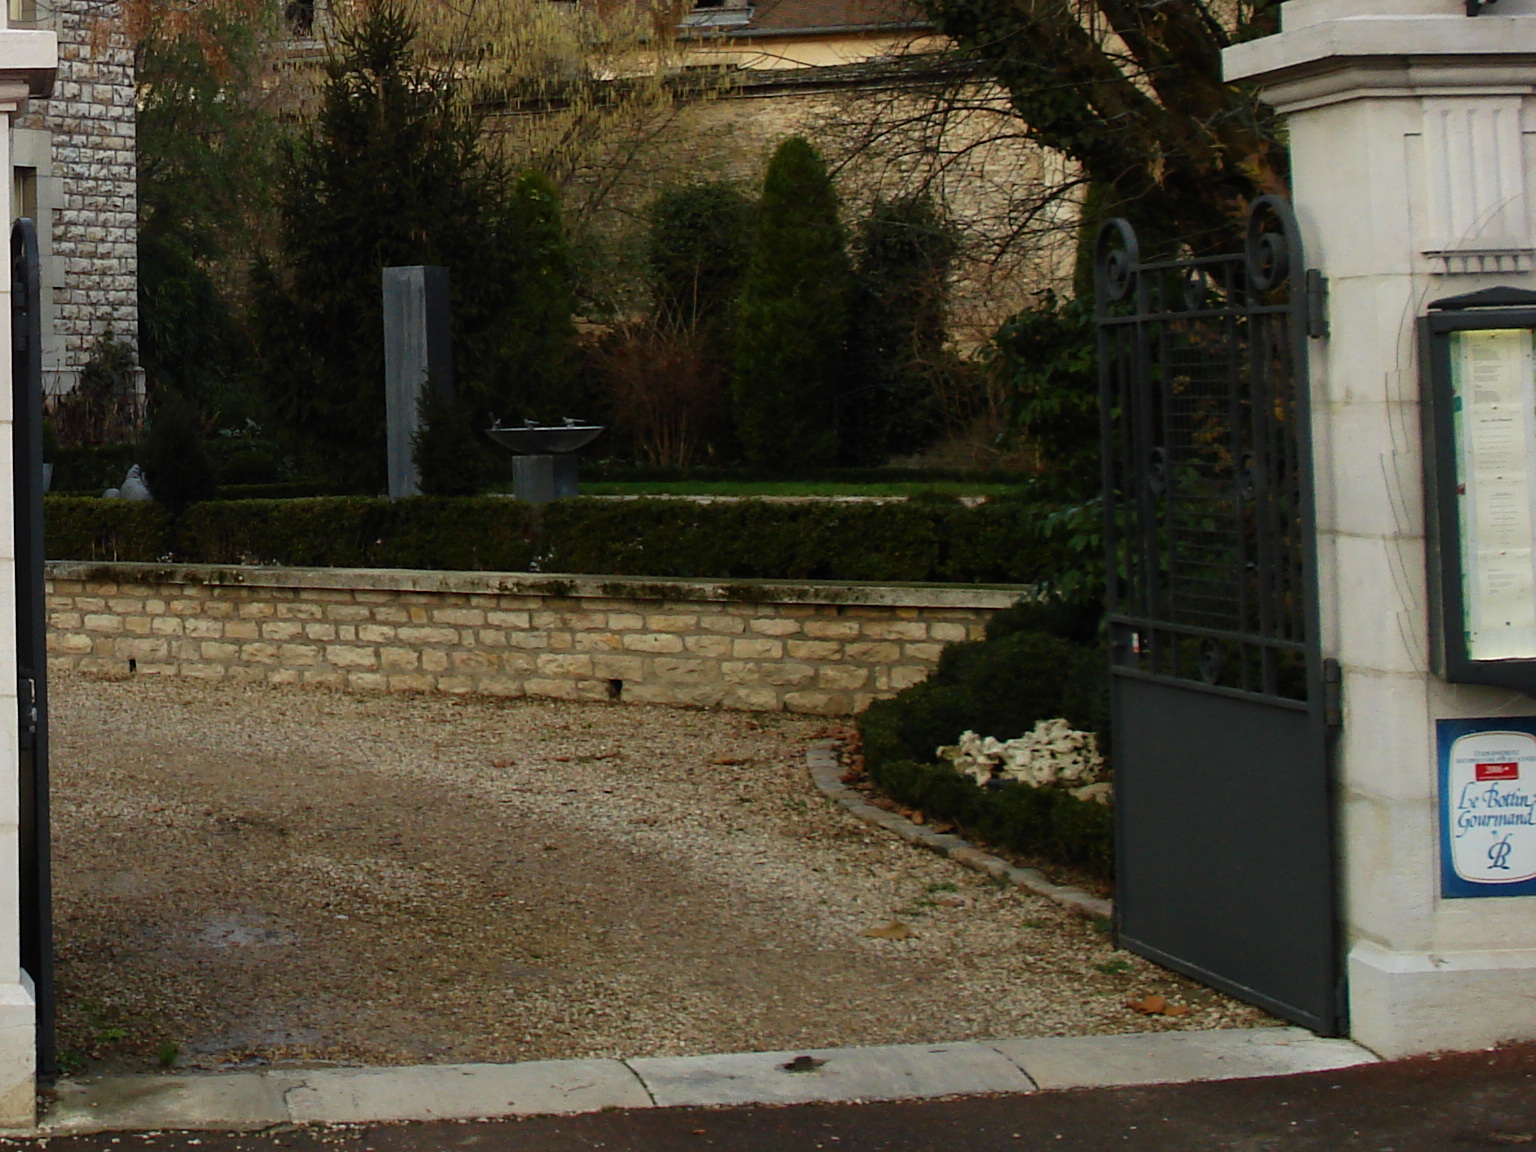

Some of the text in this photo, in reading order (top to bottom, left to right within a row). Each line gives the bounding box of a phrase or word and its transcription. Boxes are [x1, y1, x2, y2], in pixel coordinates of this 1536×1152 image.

[1458, 781, 1534, 809] Le Bottin
[1455, 803, 1536, 838] Gourmand
